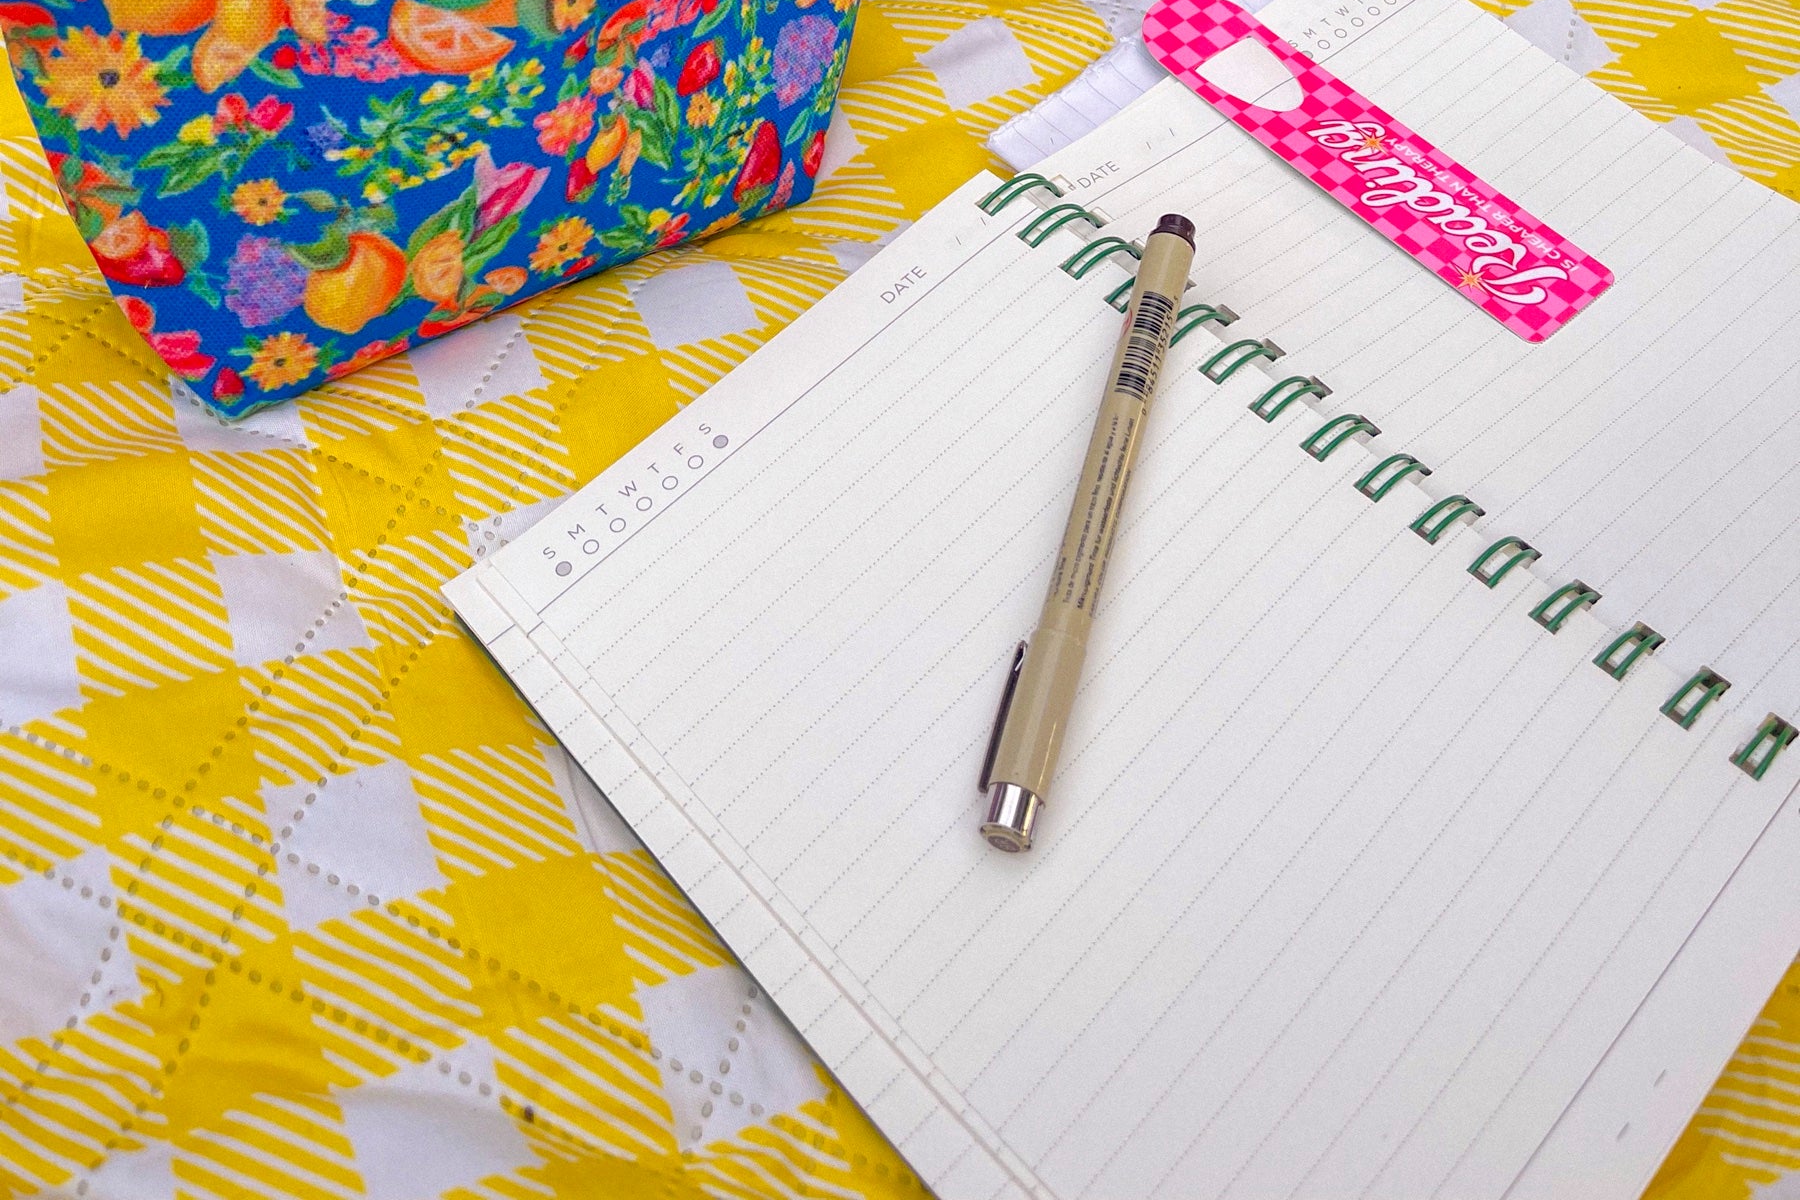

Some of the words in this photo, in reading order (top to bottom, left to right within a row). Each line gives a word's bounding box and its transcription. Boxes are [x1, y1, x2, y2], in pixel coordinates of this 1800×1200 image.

[1302, 28, 1317, 39] M
[1320, 17, 1331, 27] T
[1334, 5, 1350, 17] W
[1076, 159, 1121, 191] DATE
[1385, 137, 1452, 183] THERAPY
[1306, 119, 1569, 305] Reading
[1449, 181, 1494, 213] THAN
[1491, 212, 1561, 260] CHEAPER
[879, 264, 928, 305] DATE
[1561, 259, 1580, 272] IS
[542, 546, 557, 560] S
[567, 523, 586, 541] M
[595, 503, 608, 516] T
[618, 480, 638, 498] W
[646, 462, 660, 474] T
[673, 442, 684, 456] F
[698, 423, 712, 435] S
